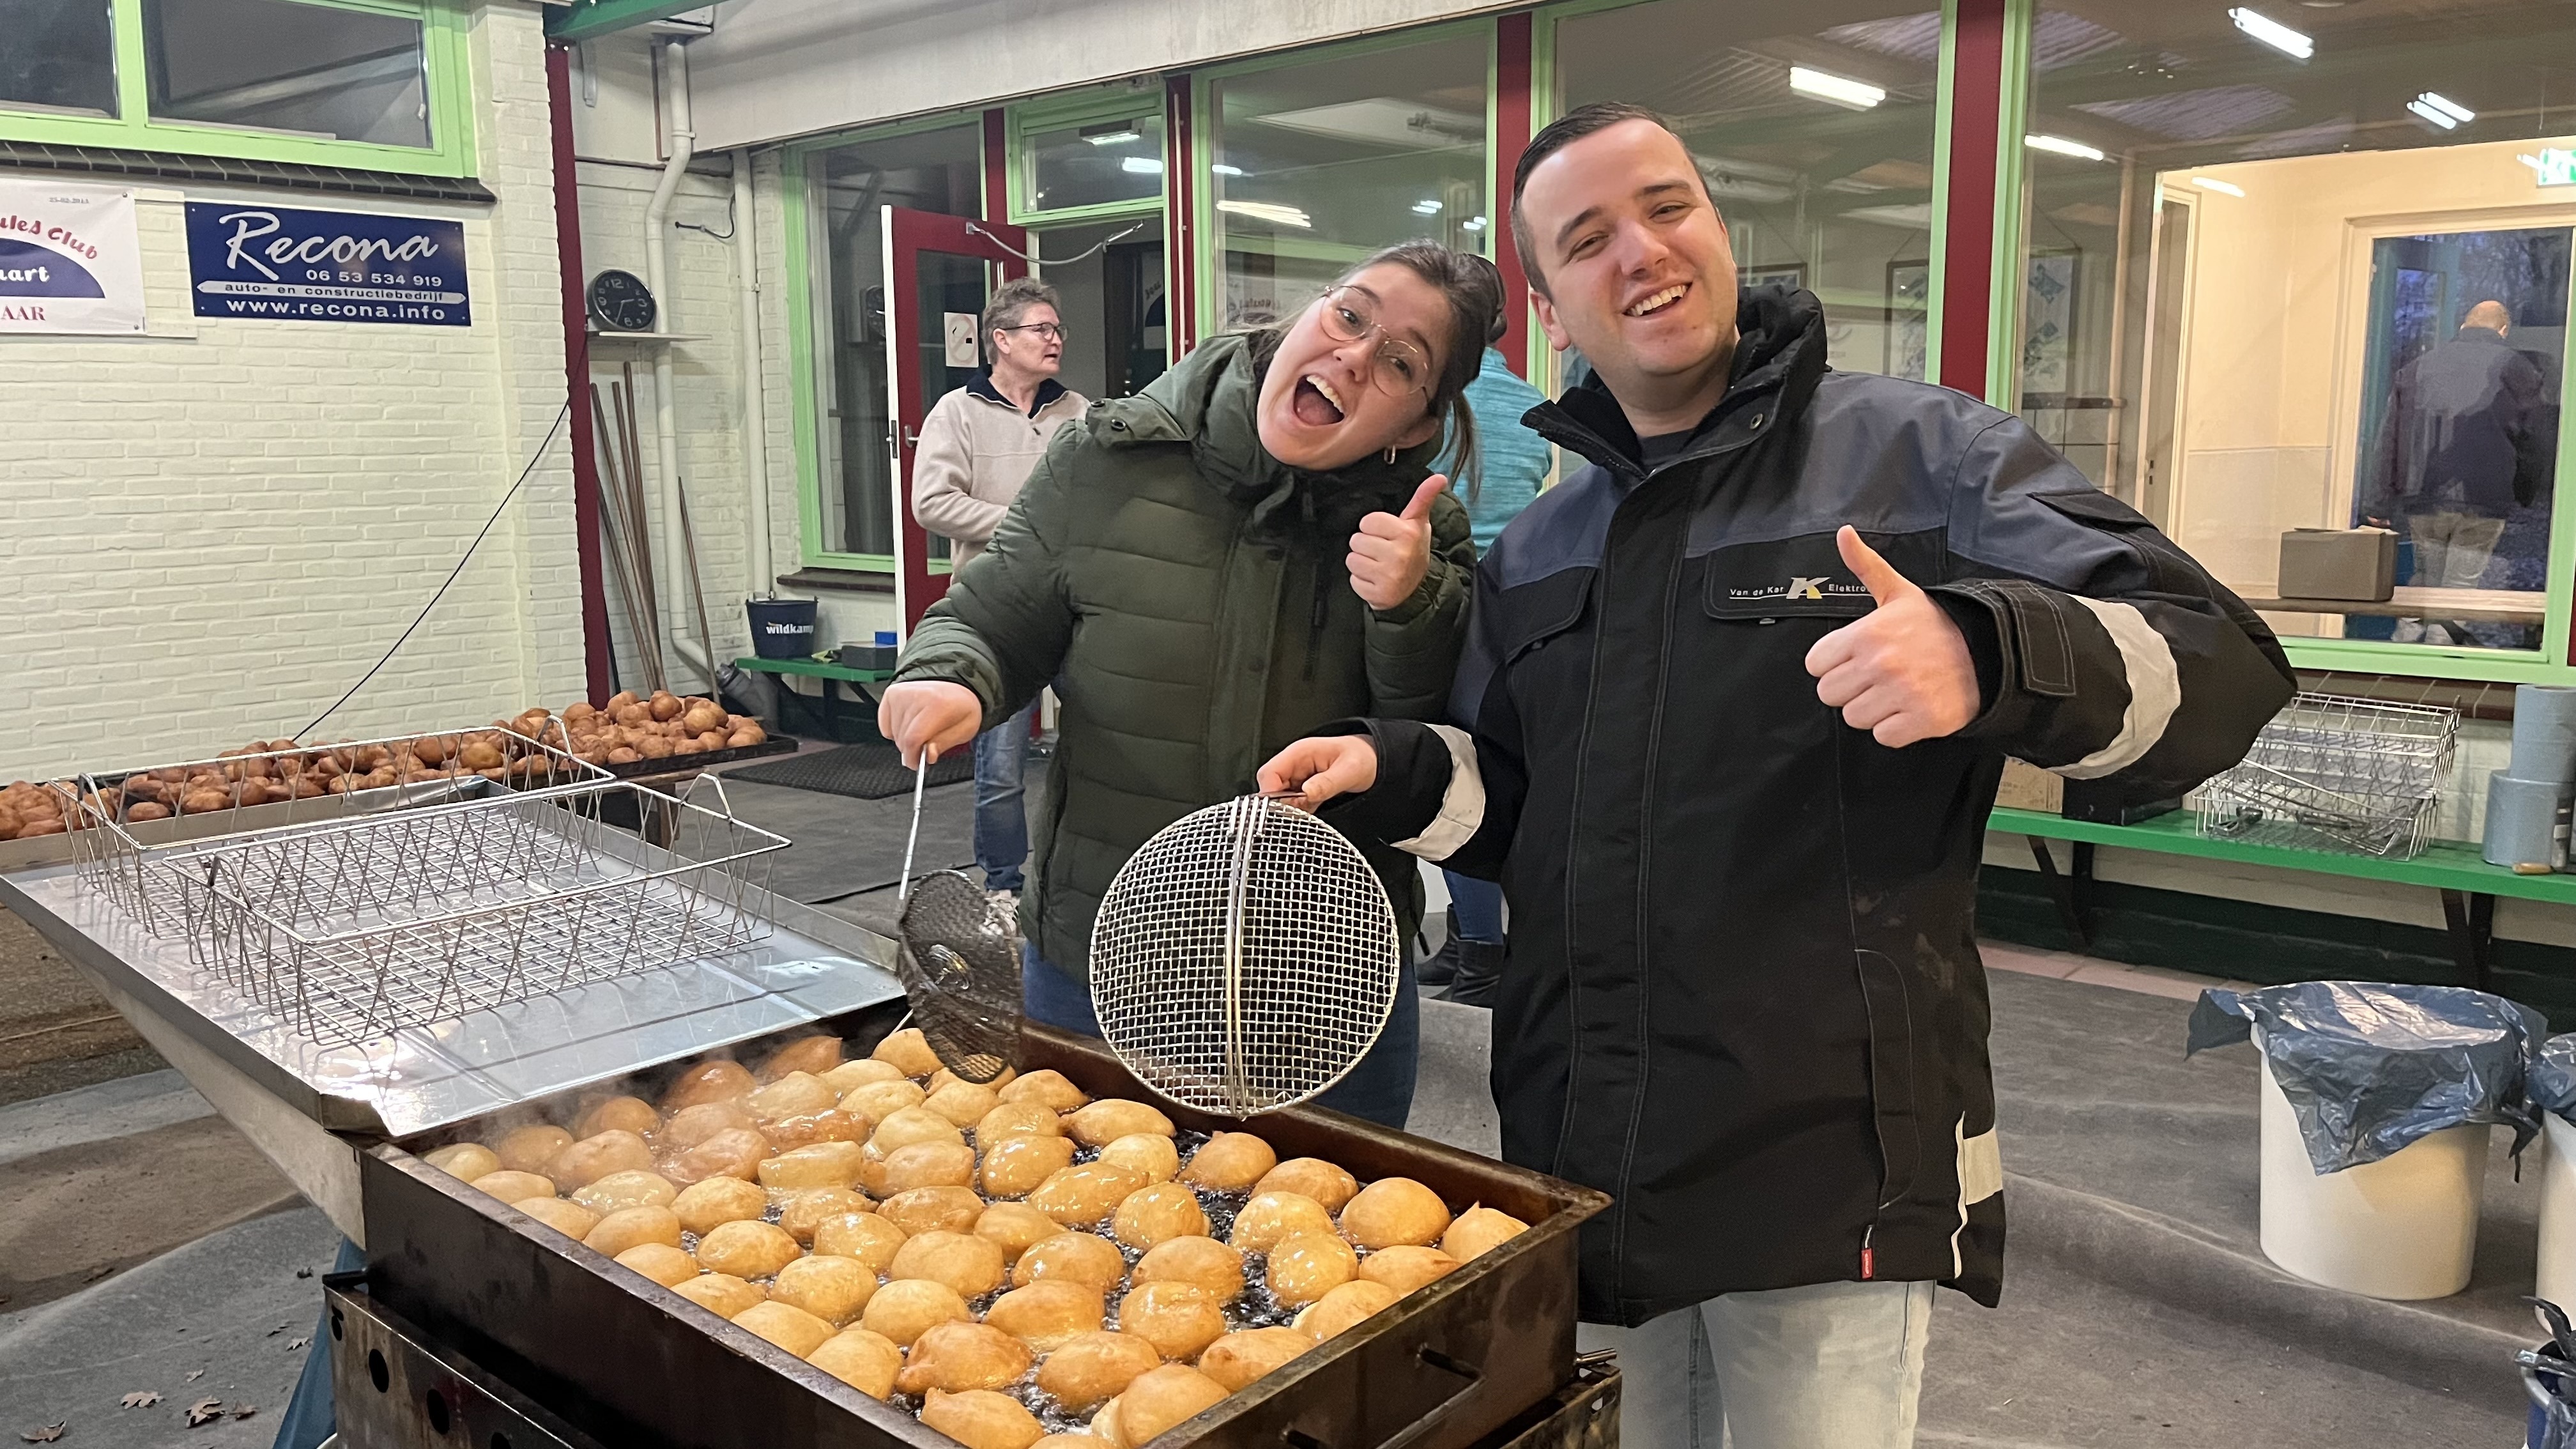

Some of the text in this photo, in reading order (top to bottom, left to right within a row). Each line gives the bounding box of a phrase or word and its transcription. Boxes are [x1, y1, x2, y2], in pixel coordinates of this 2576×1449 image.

[48, 227, 98, 259] Club
[219, 211, 439, 281] Recona
[306, 269, 442, 286] 06 53 534 919
[611, 279, 624, 289] 12
[225, 284, 268, 293] auto-
[305, 288, 443, 302] constructiebedrijf
[0, 305, 46, 321] AAR
[226, 300, 445, 320] www.recona.info
[1767, 586, 1784, 594] Kar
[1786, 577, 1831, 599] K
[766, 623, 814, 634] wildkamp
